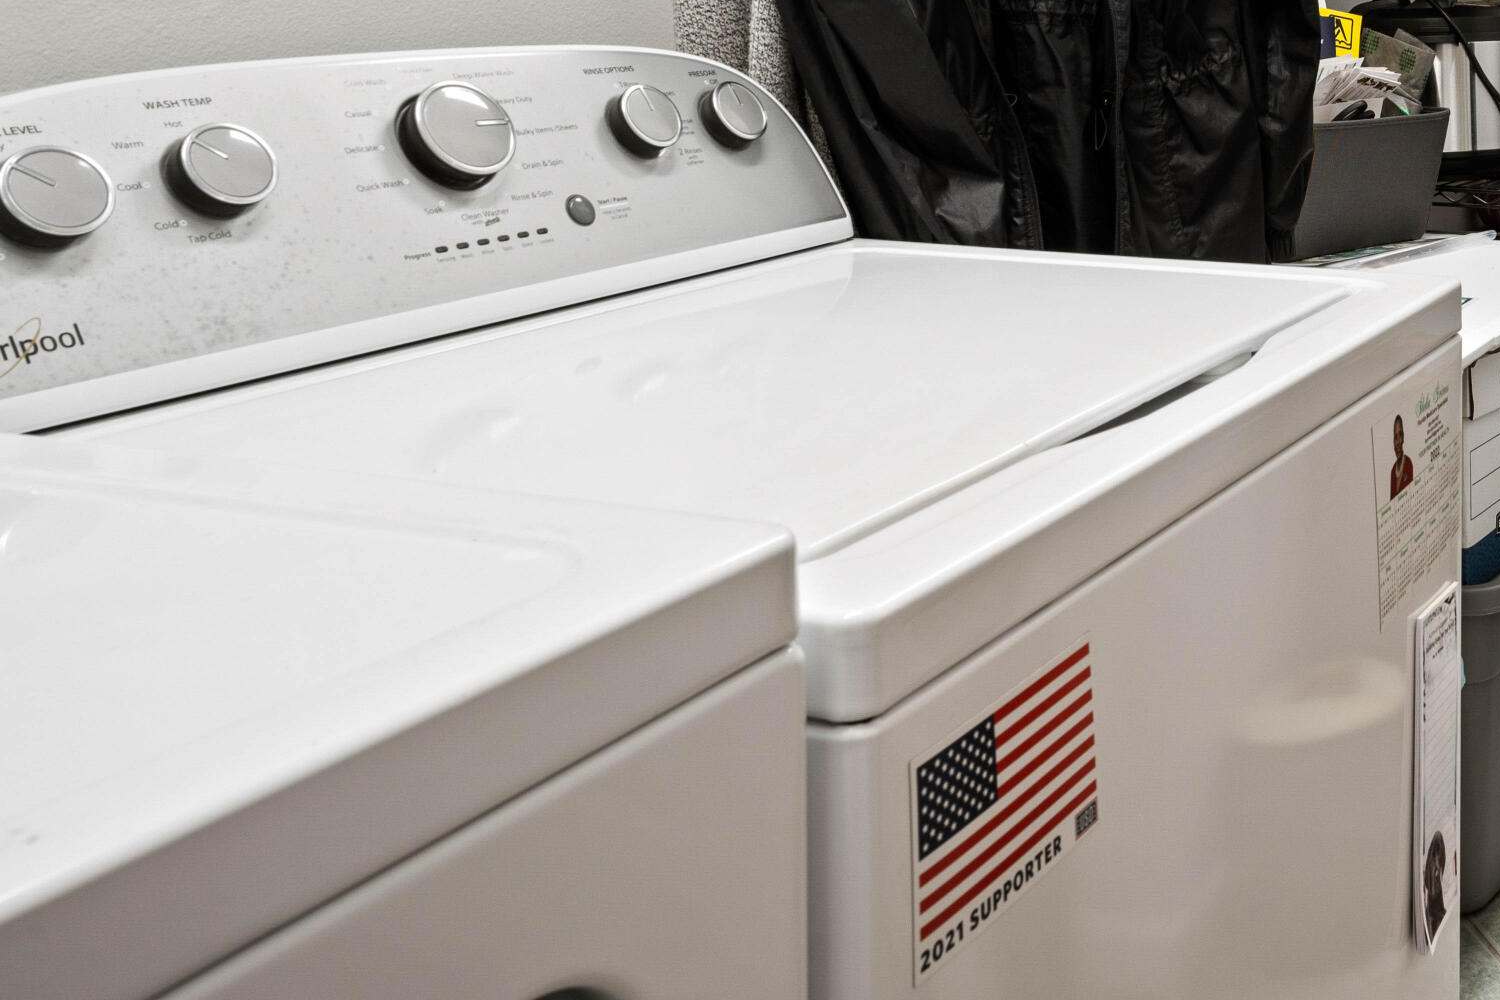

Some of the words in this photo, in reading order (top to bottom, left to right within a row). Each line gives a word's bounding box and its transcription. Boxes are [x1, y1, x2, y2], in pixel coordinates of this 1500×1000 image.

[583, 67, 604, 75] RINSE
[604, 65, 634, 74] OPTIONS
[688, 69, 716, 78] PRESOAK
[143, 99, 180, 110] WASH
[182, 96, 212, 108] TEMP
[514, 96, 533, 104] Duty
[164, 119, 183, 129] Hot
[2, 125, 43, 136] LEVEL
[112, 140, 144, 151] Warm
[522, 161, 541, 170] Drain
[550, 158, 564, 168] Spin
[116, 181, 142, 192] Cool
[355, 182, 380, 193] Quick
[381, 180, 404, 189] Wash
[511, 193, 530, 201] Rinse
[537, 190, 553, 200] Spin
[423, 206, 442, 216] Soak
[461, 211, 483, 222] Clean
[483, 207, 510, 218] Washer
[154, 219, 179, 231] Cold
[187, 233, 208, 245] Tap
[208, 229, 232, 241] Cold
[404, 251, 431, 261] Progress
[920, 921, 964, 974] 2021
[969, 835, 1062, 932] SUPPORTER
